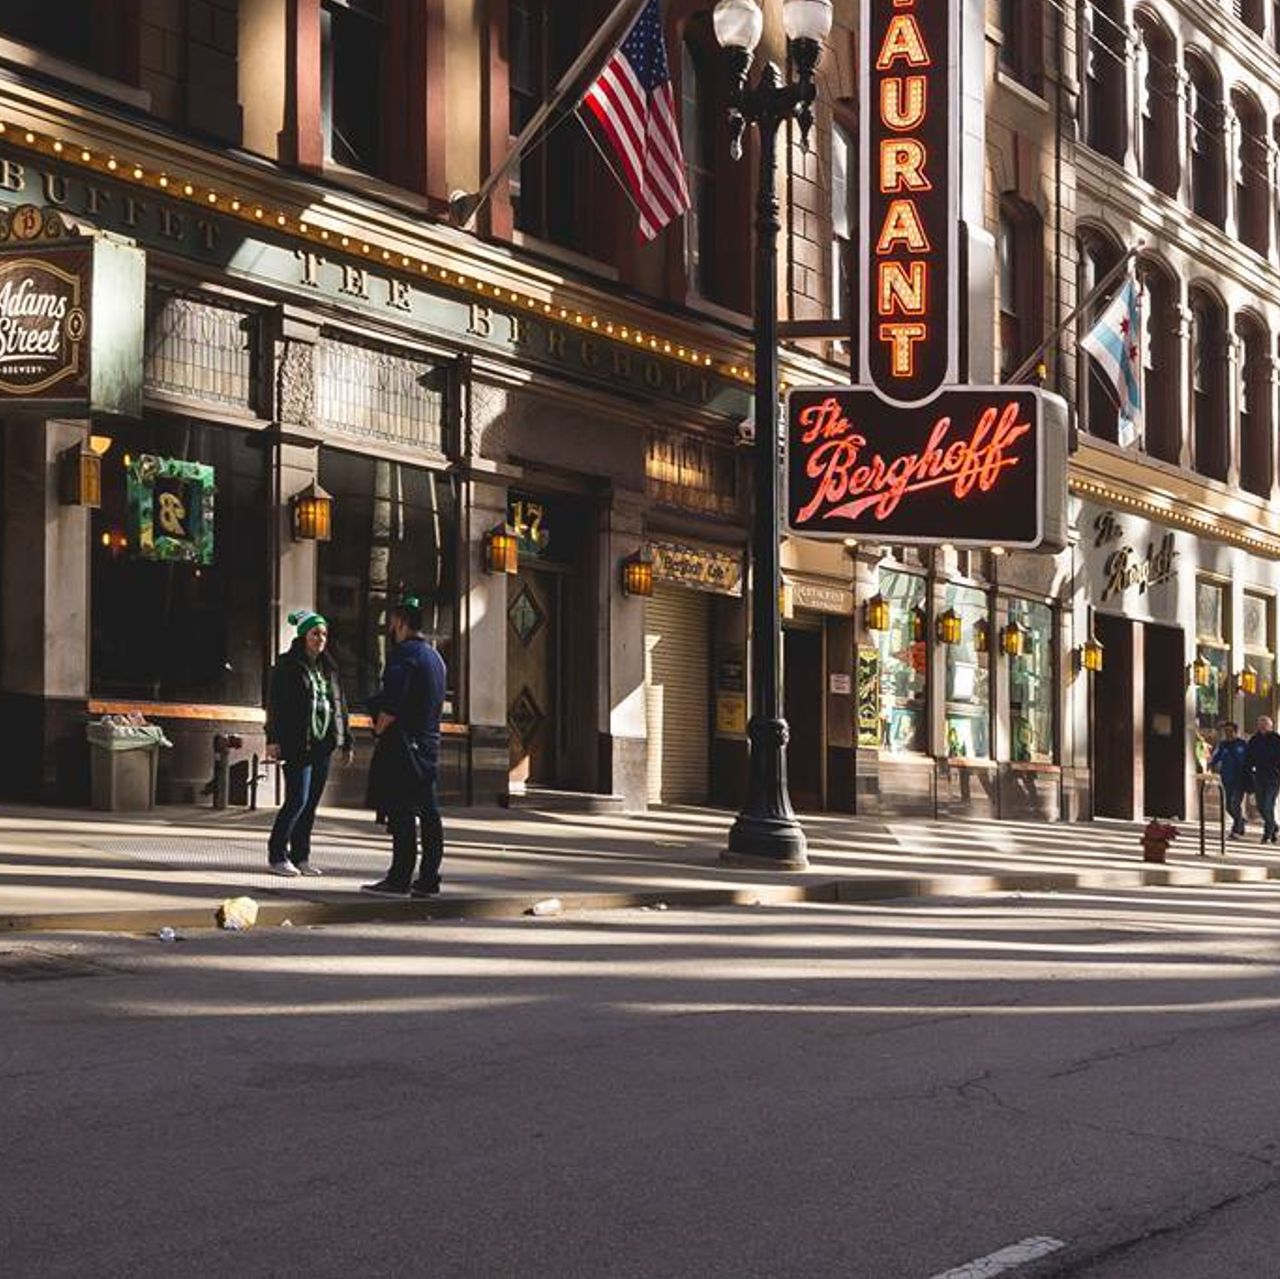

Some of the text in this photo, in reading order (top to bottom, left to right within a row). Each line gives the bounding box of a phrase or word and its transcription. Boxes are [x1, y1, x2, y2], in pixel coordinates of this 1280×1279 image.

[294, 249, 412, 313] THE
[798, 397, 853, 444] The
[794, 402, 1032, 523] Berghoff
